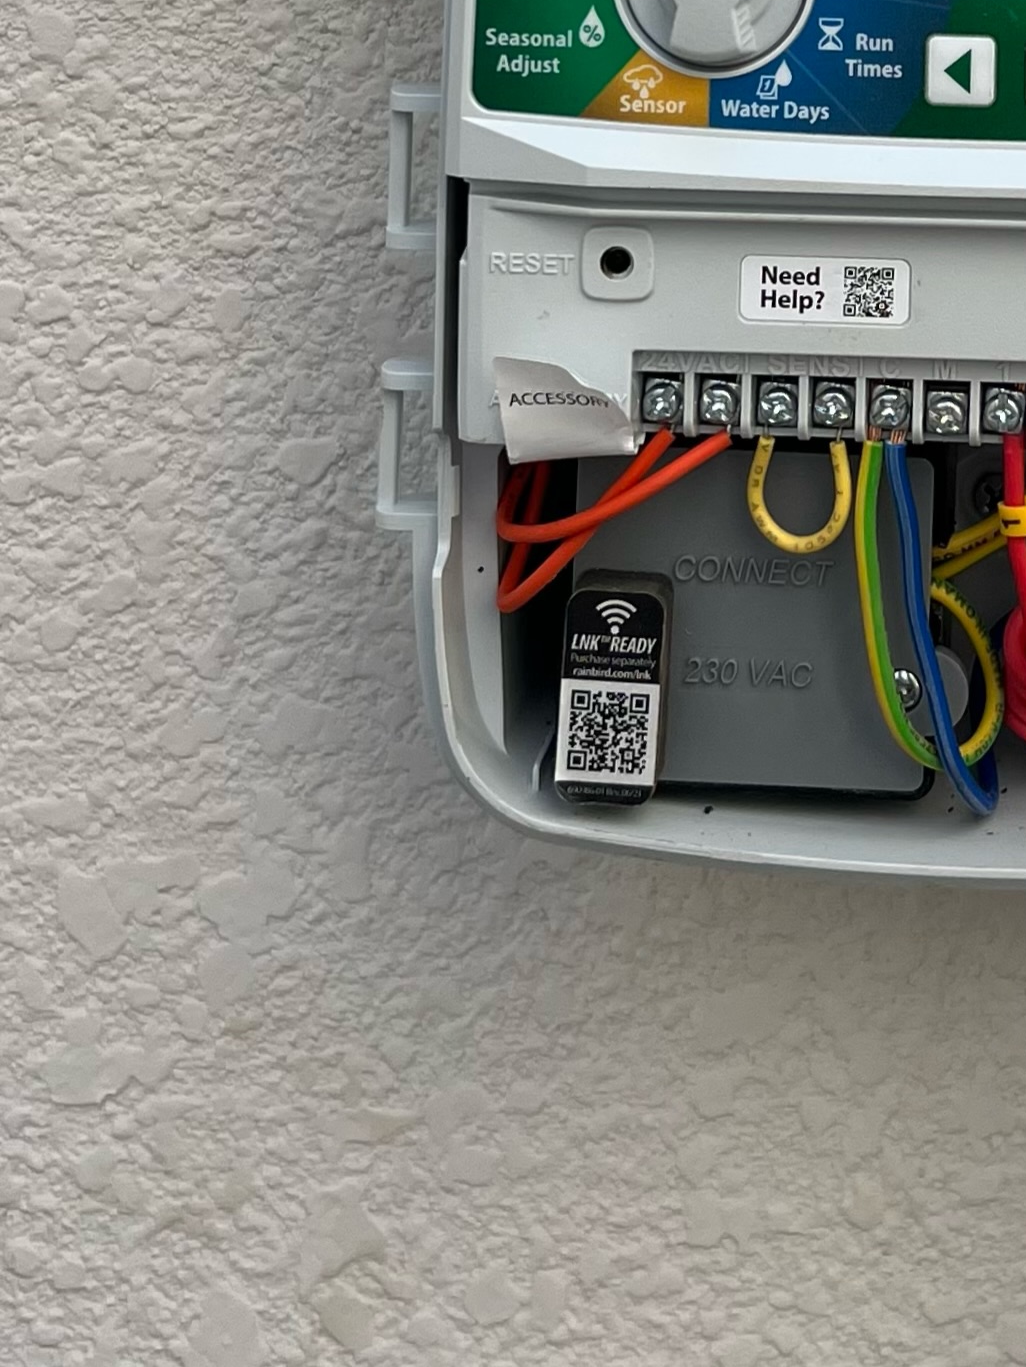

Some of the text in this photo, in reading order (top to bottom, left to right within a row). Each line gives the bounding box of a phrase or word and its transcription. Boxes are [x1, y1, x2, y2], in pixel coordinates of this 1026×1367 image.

[486, 28, 572, 47] Seasonal
[856, 33, 893, 51] Run
[497, 55, 560, 77] Adjust
[845, 59, 902, 78] Times
[620, 95, 686, 114] Sensor
[721, 99, 829, 124] Water Days
[490, 253, 574, 275] RESET
[762, 266, 820, 285] Need
[761, 289, 824, 314] Help?
[767, 357, 852, 377] SENS
[508, 391, 609, 408] ACCESSORY
[1001, 517, 1021, 530] 1
[674, 555, 835, 586] CONNECT
[610, 636, 657, 654] READY
[570, 652, 656, 669] Purchase separately
[572, 666, 652, 680] rainbird.com/lnk
[685, 657, 813, 687] 230 VAC
